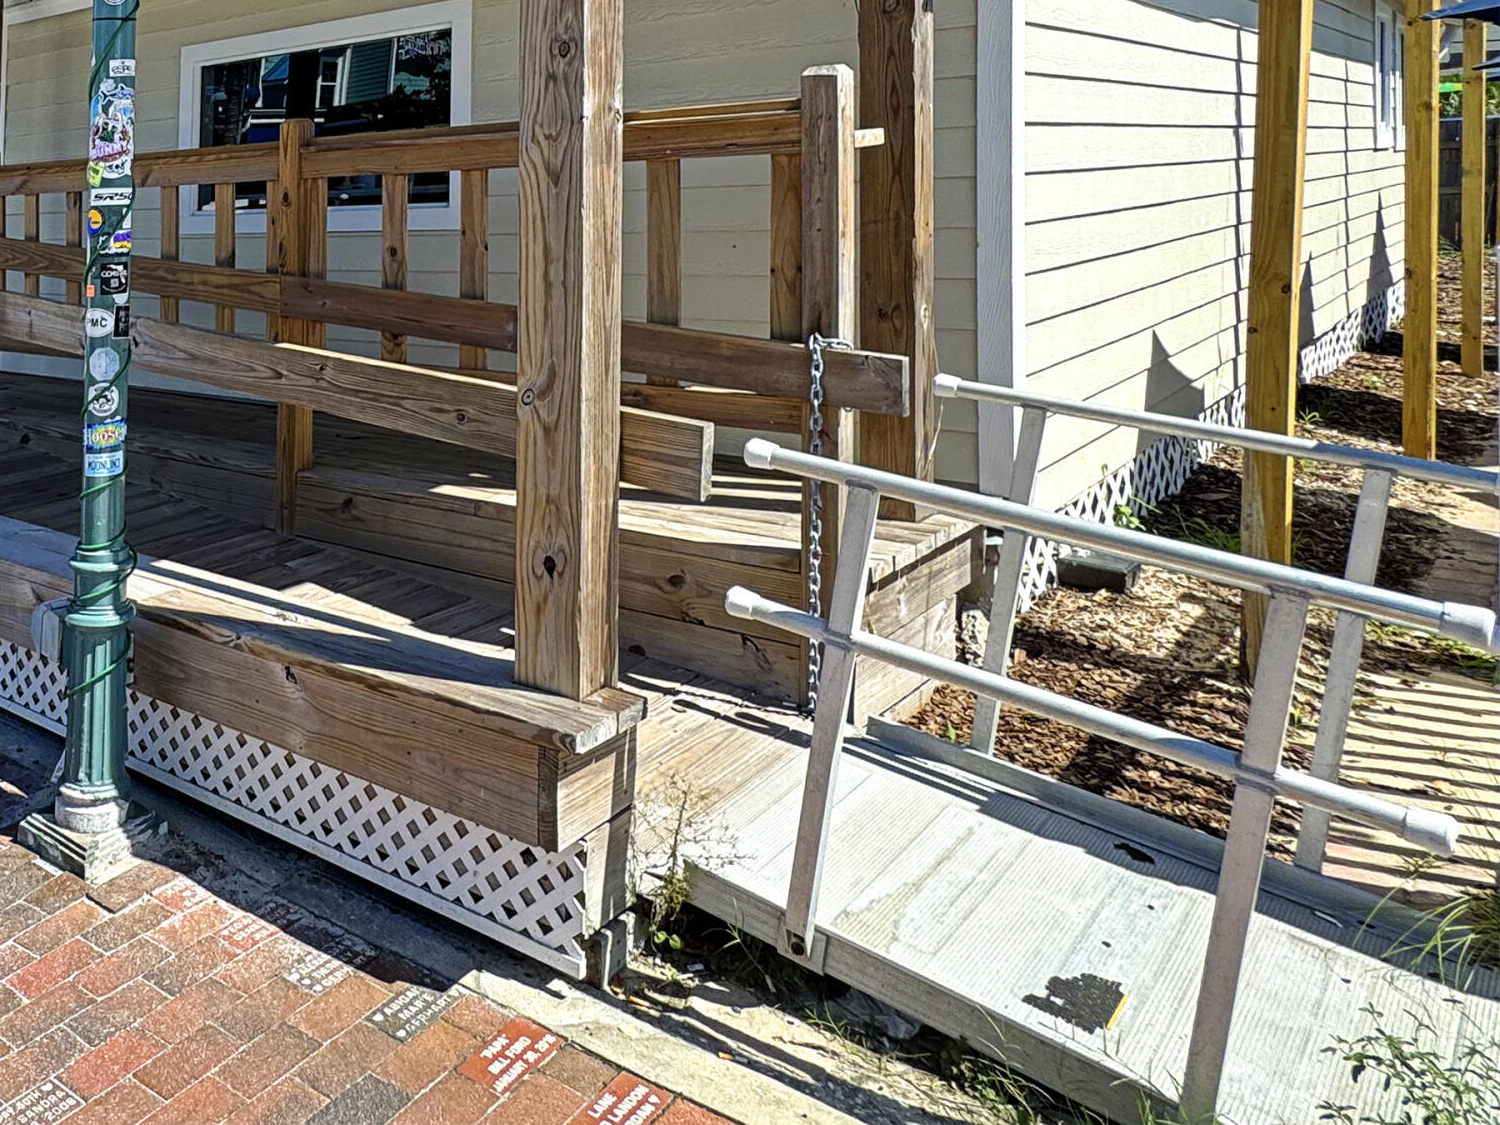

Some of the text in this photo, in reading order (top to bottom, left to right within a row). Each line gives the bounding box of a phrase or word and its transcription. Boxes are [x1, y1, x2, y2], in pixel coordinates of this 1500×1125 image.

[504, 1035, 531, 1059] FORD
[492, 1059, 528, 1093] JANUARY
[17, 1090, 66, 1124] SANDRA
[587, 1092, 617, 1119] LANE
[607, 1083, 650, 1123] LANDON
